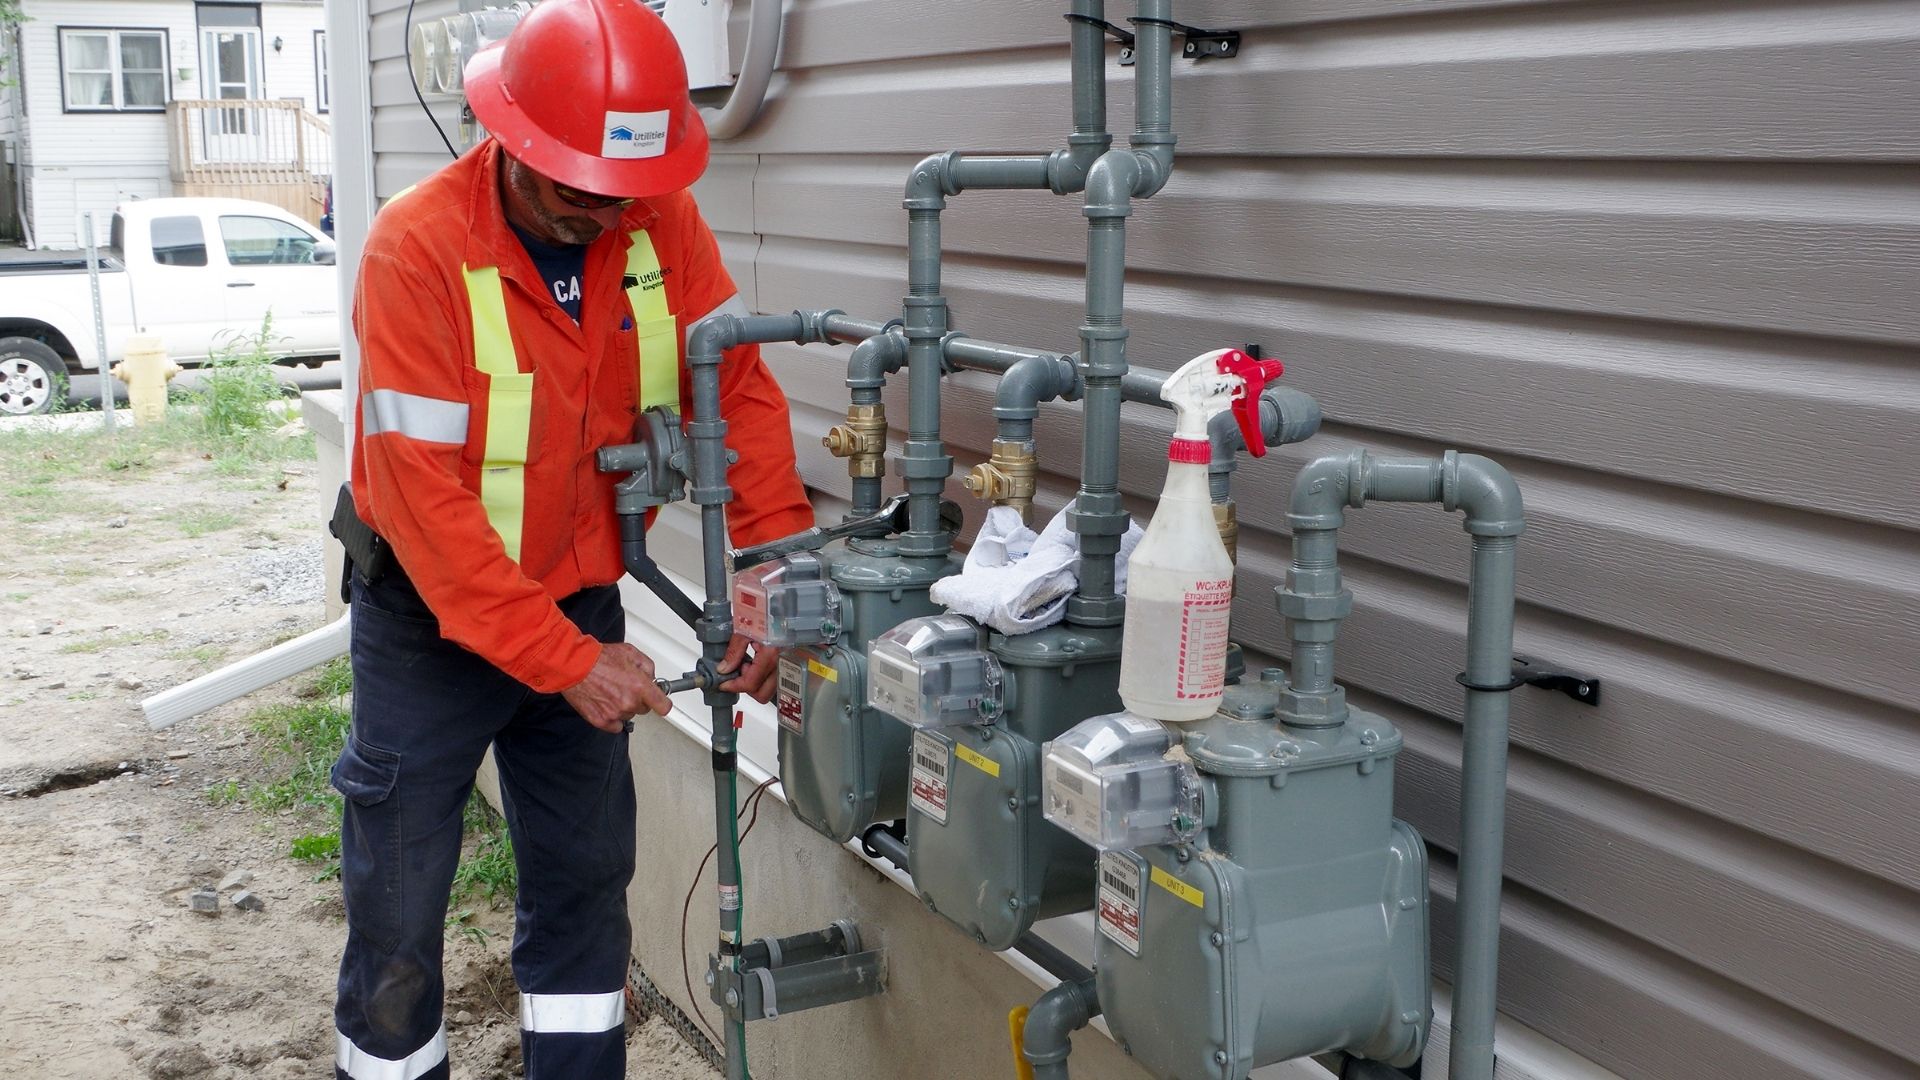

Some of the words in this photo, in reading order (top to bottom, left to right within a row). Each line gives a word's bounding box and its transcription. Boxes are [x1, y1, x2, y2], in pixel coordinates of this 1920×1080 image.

[634, 131, 665, 141] Utilities
[1118, 858, 1138, 876] KINGSTON
[1166, 878, 1180, 892] UNIT
